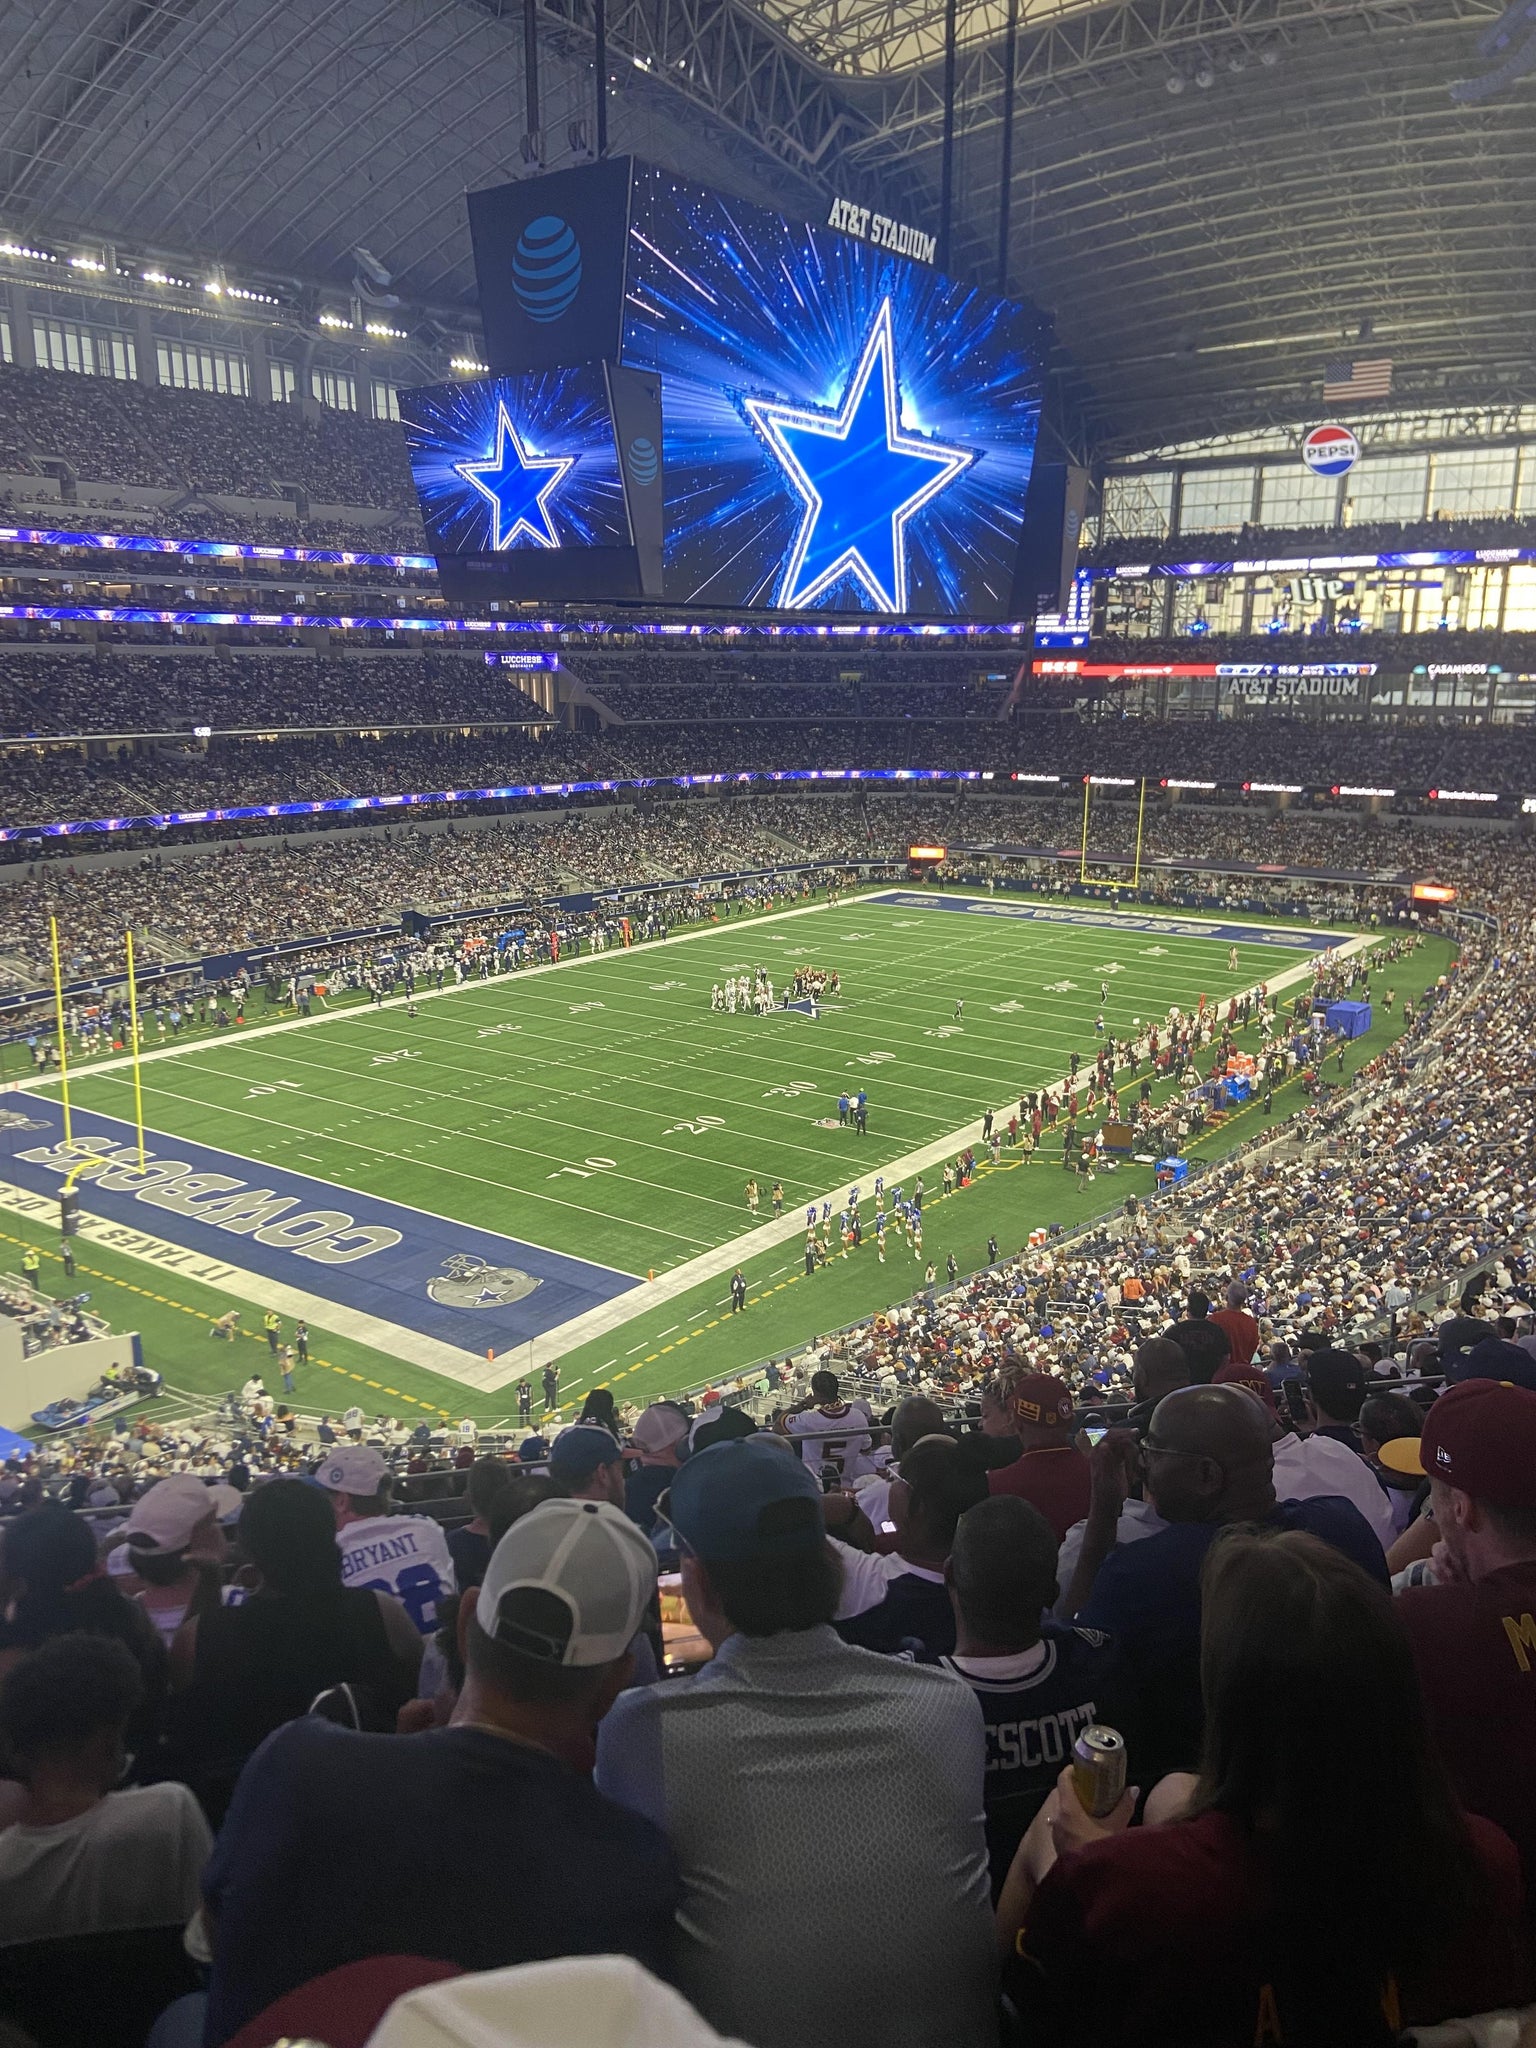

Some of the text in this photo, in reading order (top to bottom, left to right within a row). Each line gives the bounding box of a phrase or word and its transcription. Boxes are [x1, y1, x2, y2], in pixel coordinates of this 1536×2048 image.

[828, 198, 936, 264] AT&T STADIUM
[1307, 446, 1355, 458] PEPSI
[1288, 577, 1344, 607] Lite
[501, 655, 543, 664] LUCCHESE
[1427, 664, 1488, 675] CASAMIGOS
[1228, 678, 1360, 696] AT&T STADIUM
[967, 904, 1222, 935] COWBOYS
[923, 1025, 964, 1039] 50
[372, 1048, 423, 1063] 20
[856, 1050, 897, 1065] 40
[248, 1079, 304, 1095] 10
[769, 1081, 818, 1098] 30
[672, 1115, 726, 1135] 20
[559, 1156, 618, 1179] 10
[12, 1136, 403, 1264] COWBOYS
[97, 1228, 196, 1267] TAKES
[190, 1264, 238, 1281] IT
[342, 1533, 419, 1579] BRYANT
